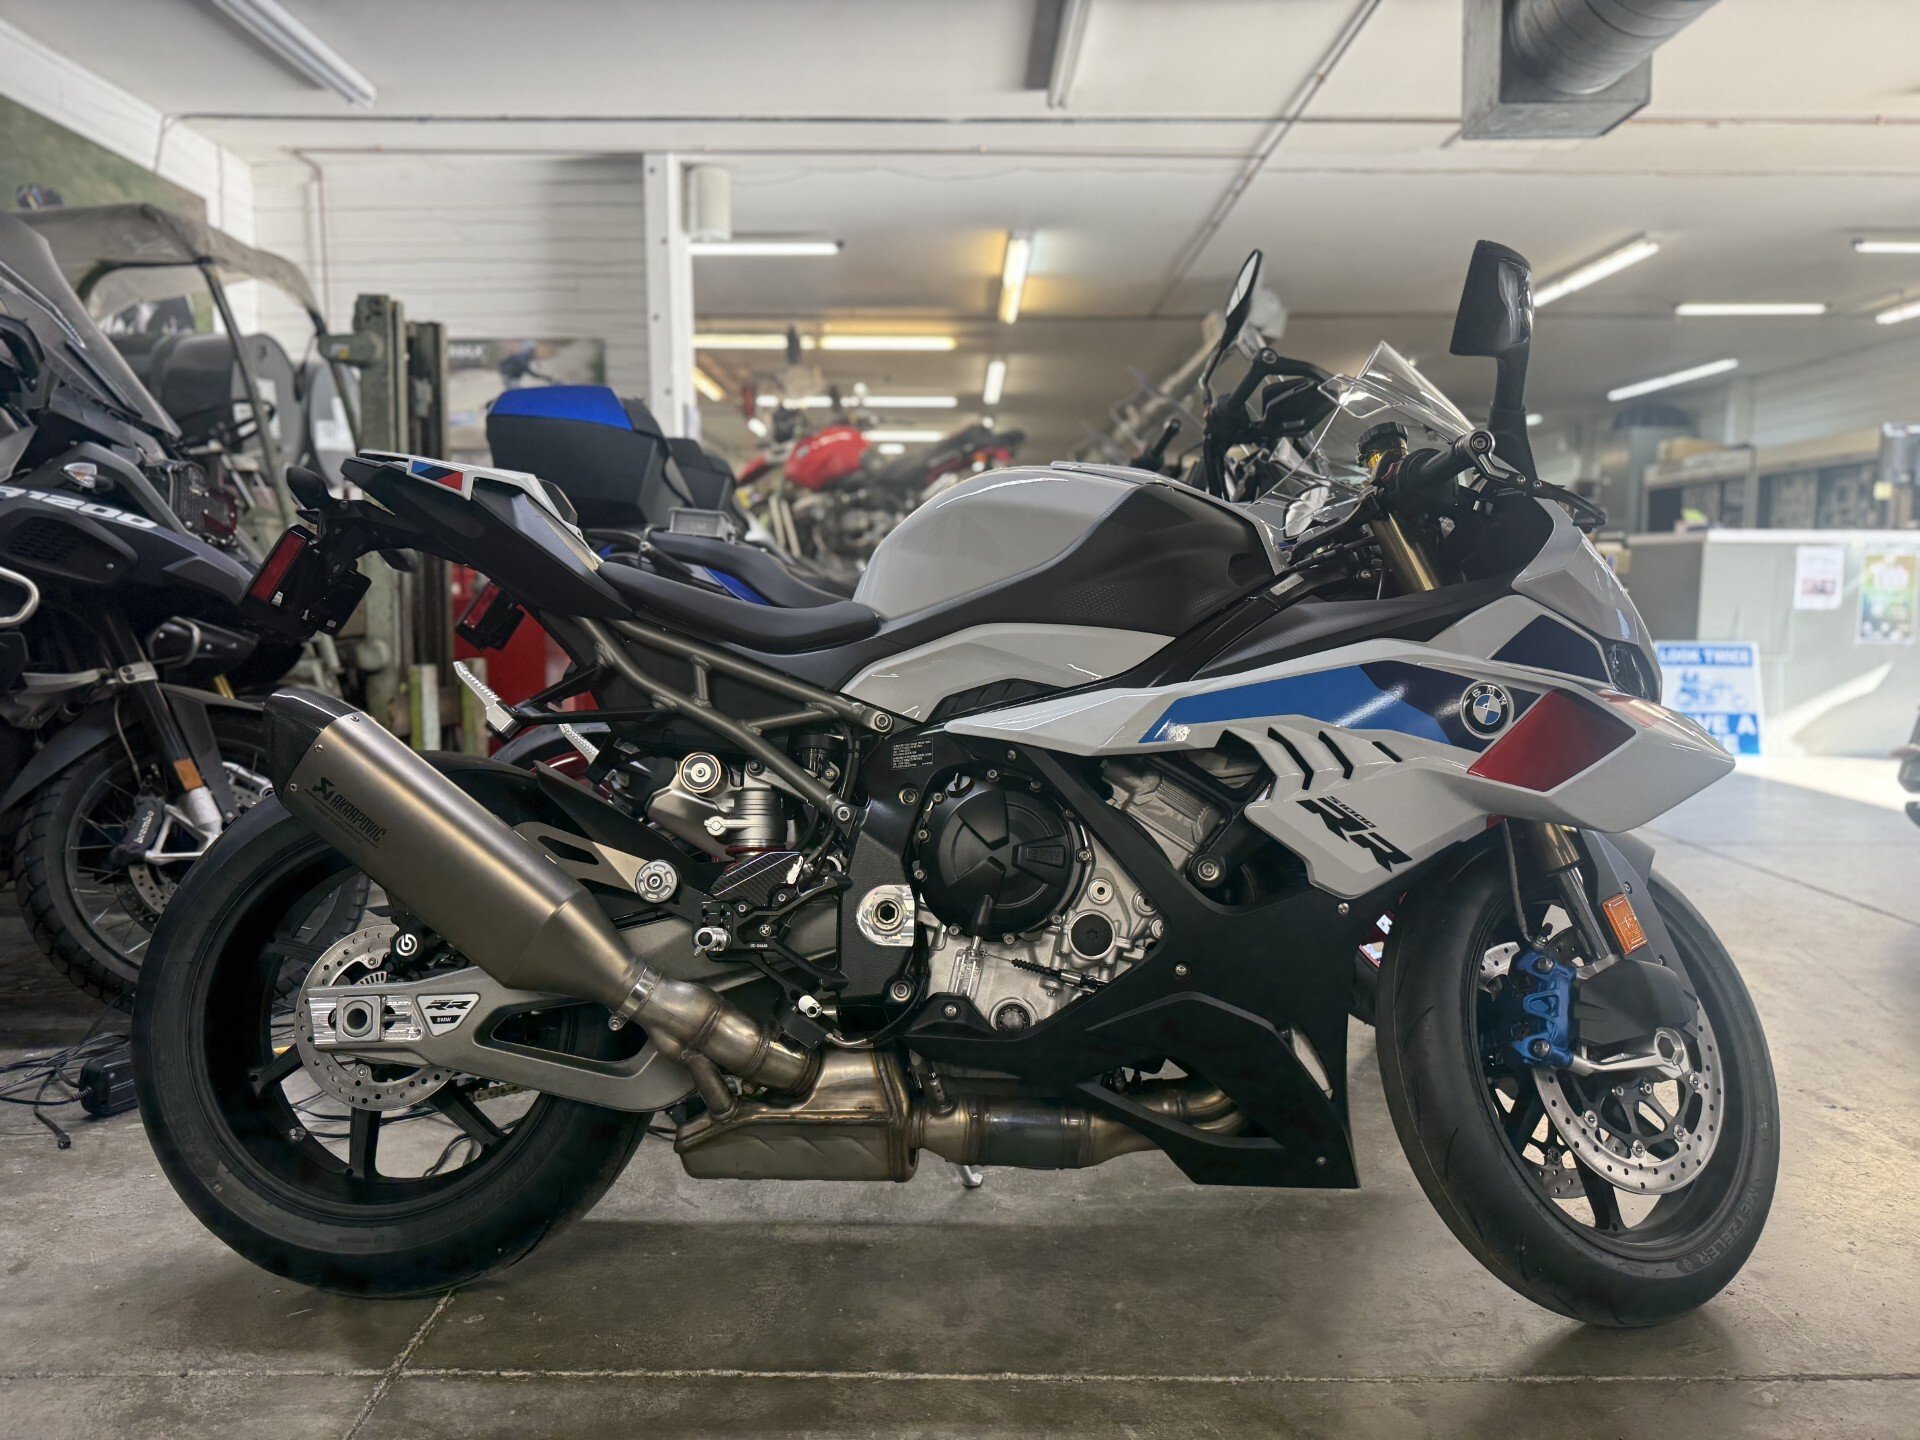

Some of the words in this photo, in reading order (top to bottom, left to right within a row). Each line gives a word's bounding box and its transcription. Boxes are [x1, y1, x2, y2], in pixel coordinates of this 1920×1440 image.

[1659, 649, 1701, 664] LOOK
[1703, 649, 1750, 664] TWICE
[1471, 685, 1507, 706] BMW
[1737, 714, 1757, 735] A
[1326, 796, 1377, 828] S1000
[134, 811, 154, 844] brembo
[1296, 797, 1413, 873] RR
[425, 1000, 472, 1010] RR
[1696, 1186, 1762, 1265] METZELER
